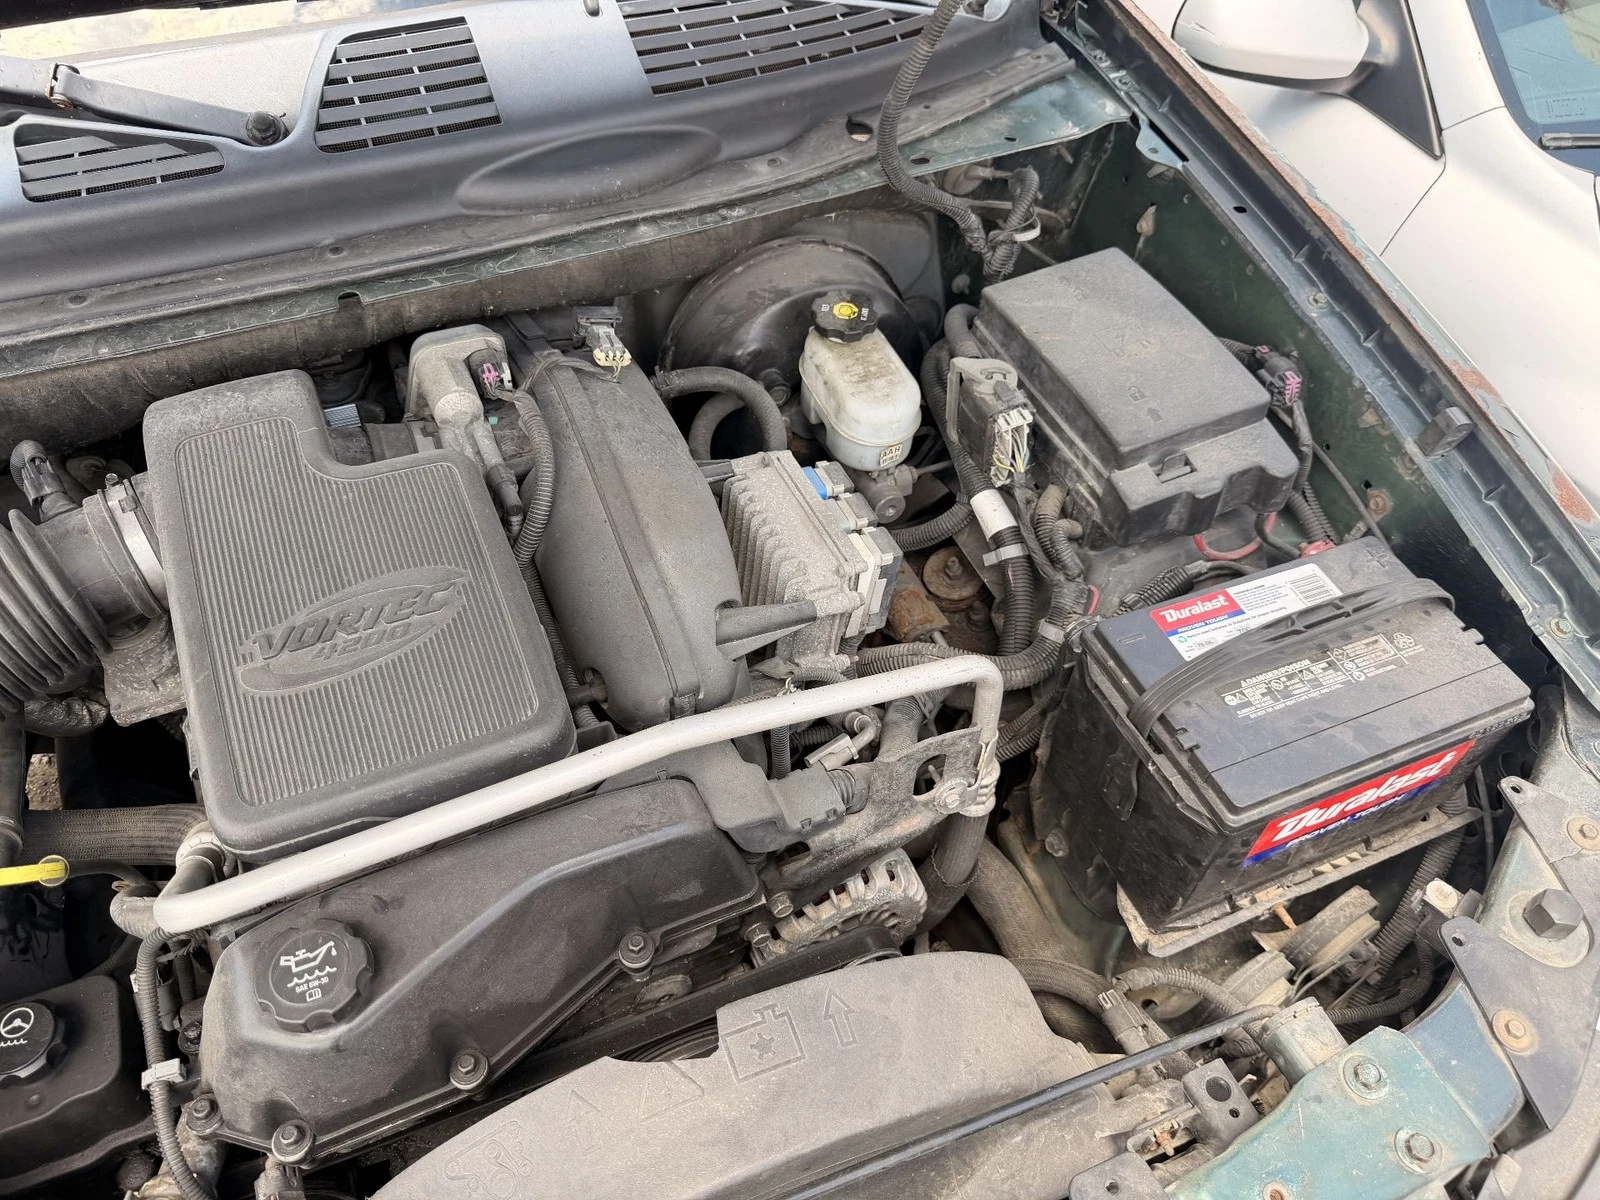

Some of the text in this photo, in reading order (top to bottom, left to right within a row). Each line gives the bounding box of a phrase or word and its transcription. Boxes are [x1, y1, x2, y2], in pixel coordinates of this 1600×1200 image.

[881, 446, 901, 458] AAH
[253, 582, 456, 660] VORTEC
[1159, 594, 1229, 623] Duralast
[1177, 614, 1229, 633] PROVEN TOUGH
[312, 623, 411, 661] 4200
[1246, 659, 1311, 684] DANGER/POISON
[1271, 751, 1457, 843] Duralast
[1285, 793, 1407, 848] PROVEN TOUGH
[295, 976, 329, 993] SAE 5W-30
